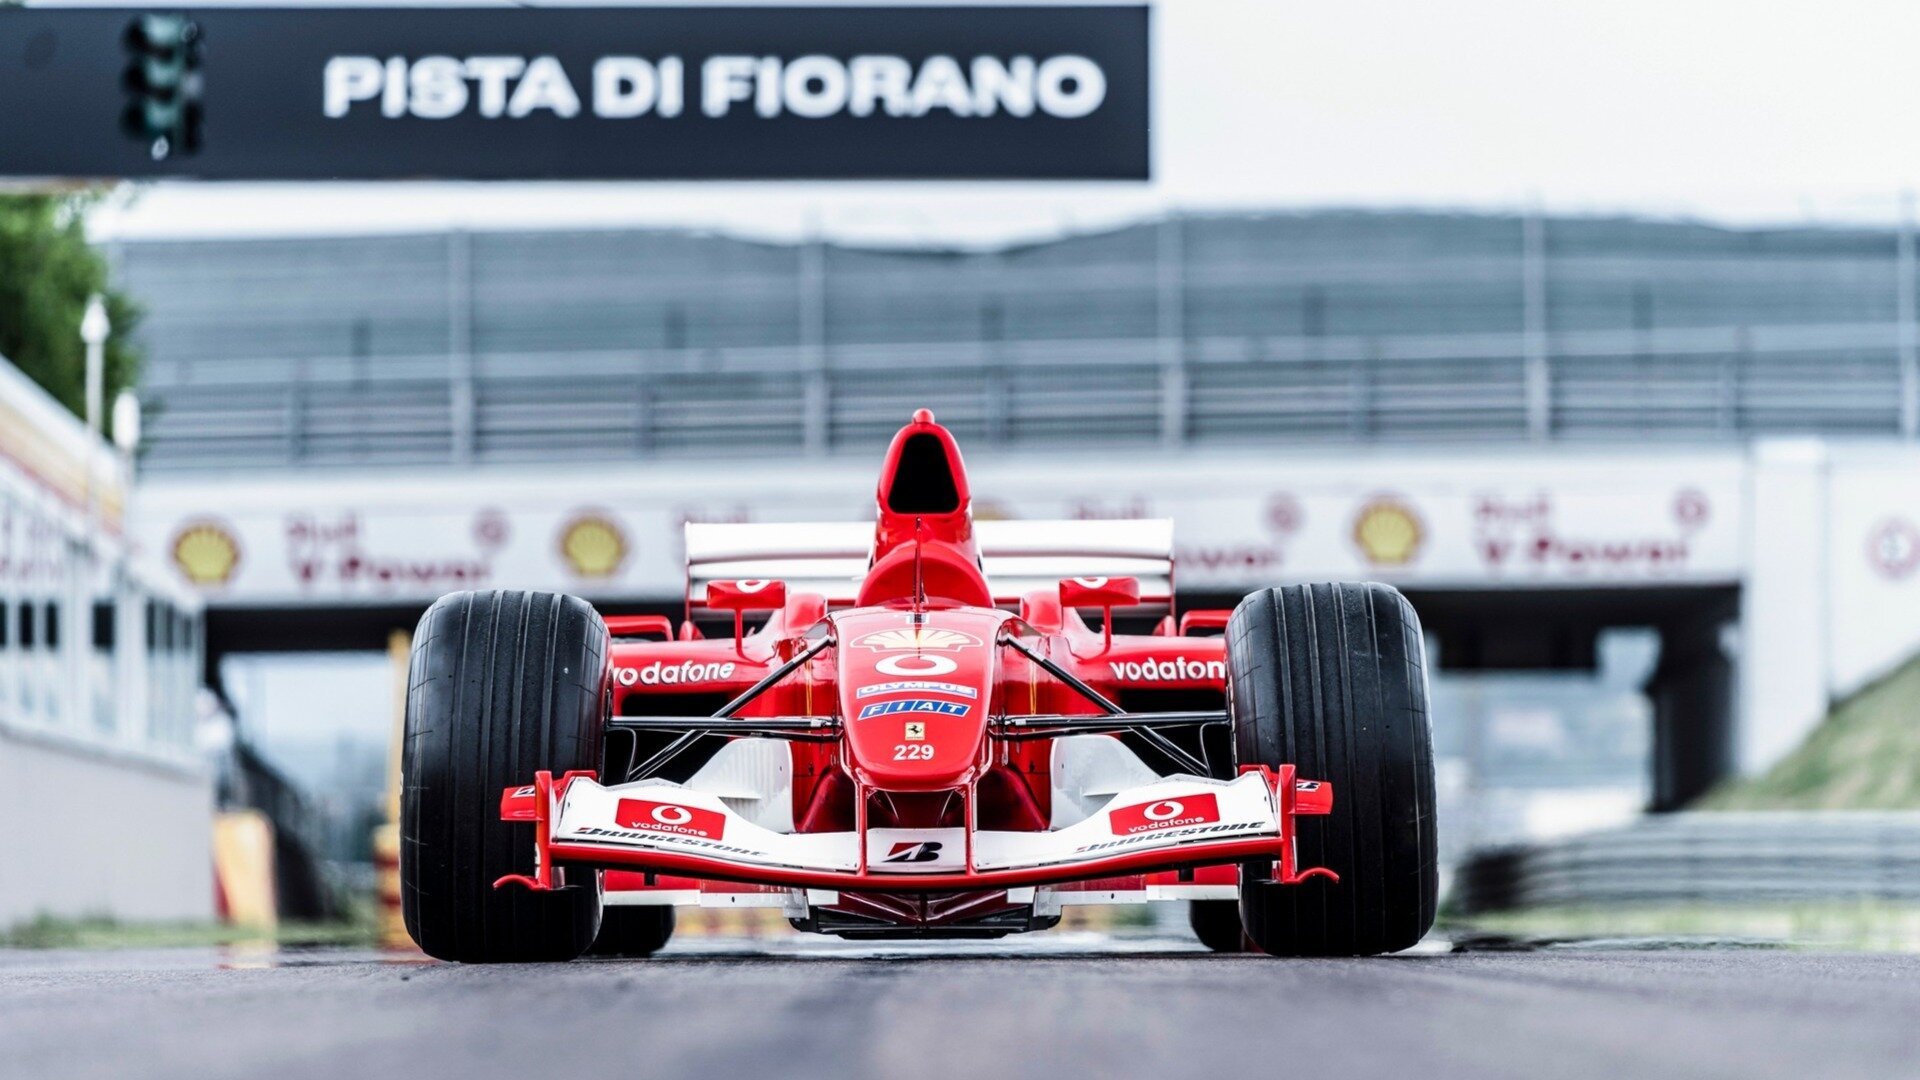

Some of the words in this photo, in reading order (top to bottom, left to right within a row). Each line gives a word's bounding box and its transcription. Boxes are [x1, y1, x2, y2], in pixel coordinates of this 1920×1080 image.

[322, 55, 582, 119] PISTA
[592, 55, 685, 119] DI
[701, 54, 1107, 119] FIORANO
[1109, 656, 1226, 681] vodafon
[860, 682, 973, 694] OLYMPUS
[868, 702, 962, 716] FIAT
[893, 744, 935, 761] 229
[631, 821, 708, 837] vodafone
[1128, 816, 1205, 833] vodafone
